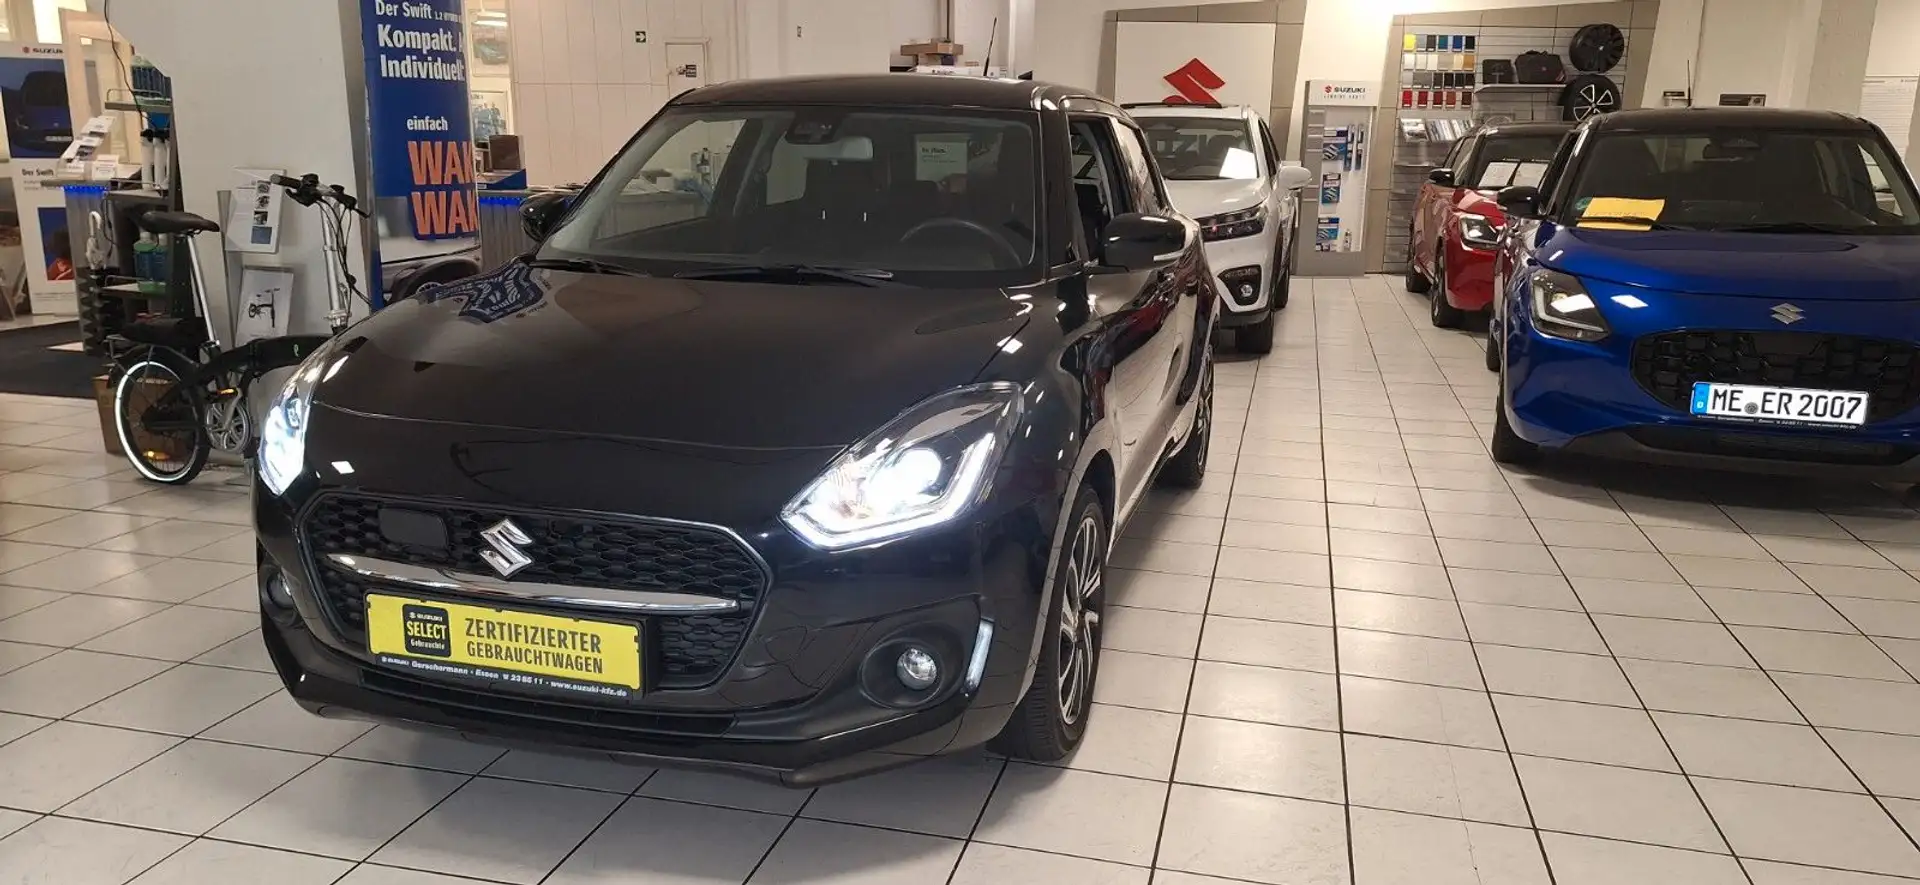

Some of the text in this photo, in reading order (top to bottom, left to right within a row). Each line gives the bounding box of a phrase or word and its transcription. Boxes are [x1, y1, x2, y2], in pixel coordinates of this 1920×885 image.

[375, 0, 399, 16] Der
[402, 1, 432, 19] Swift
[377, 23, 457, 54] Kompakt.
[1334, 86, 1366, 94] SUZUKI
[406, 115, 449, 131] einfach
[1711, 388, 1863, 420] ME ER 2007
[406, 621, 448, 639] SELECT
[464, 617, 602, 654] ZERTIFIZIERTER
[466, 640, 604, 674] GEBRAUCHTWAGEN
